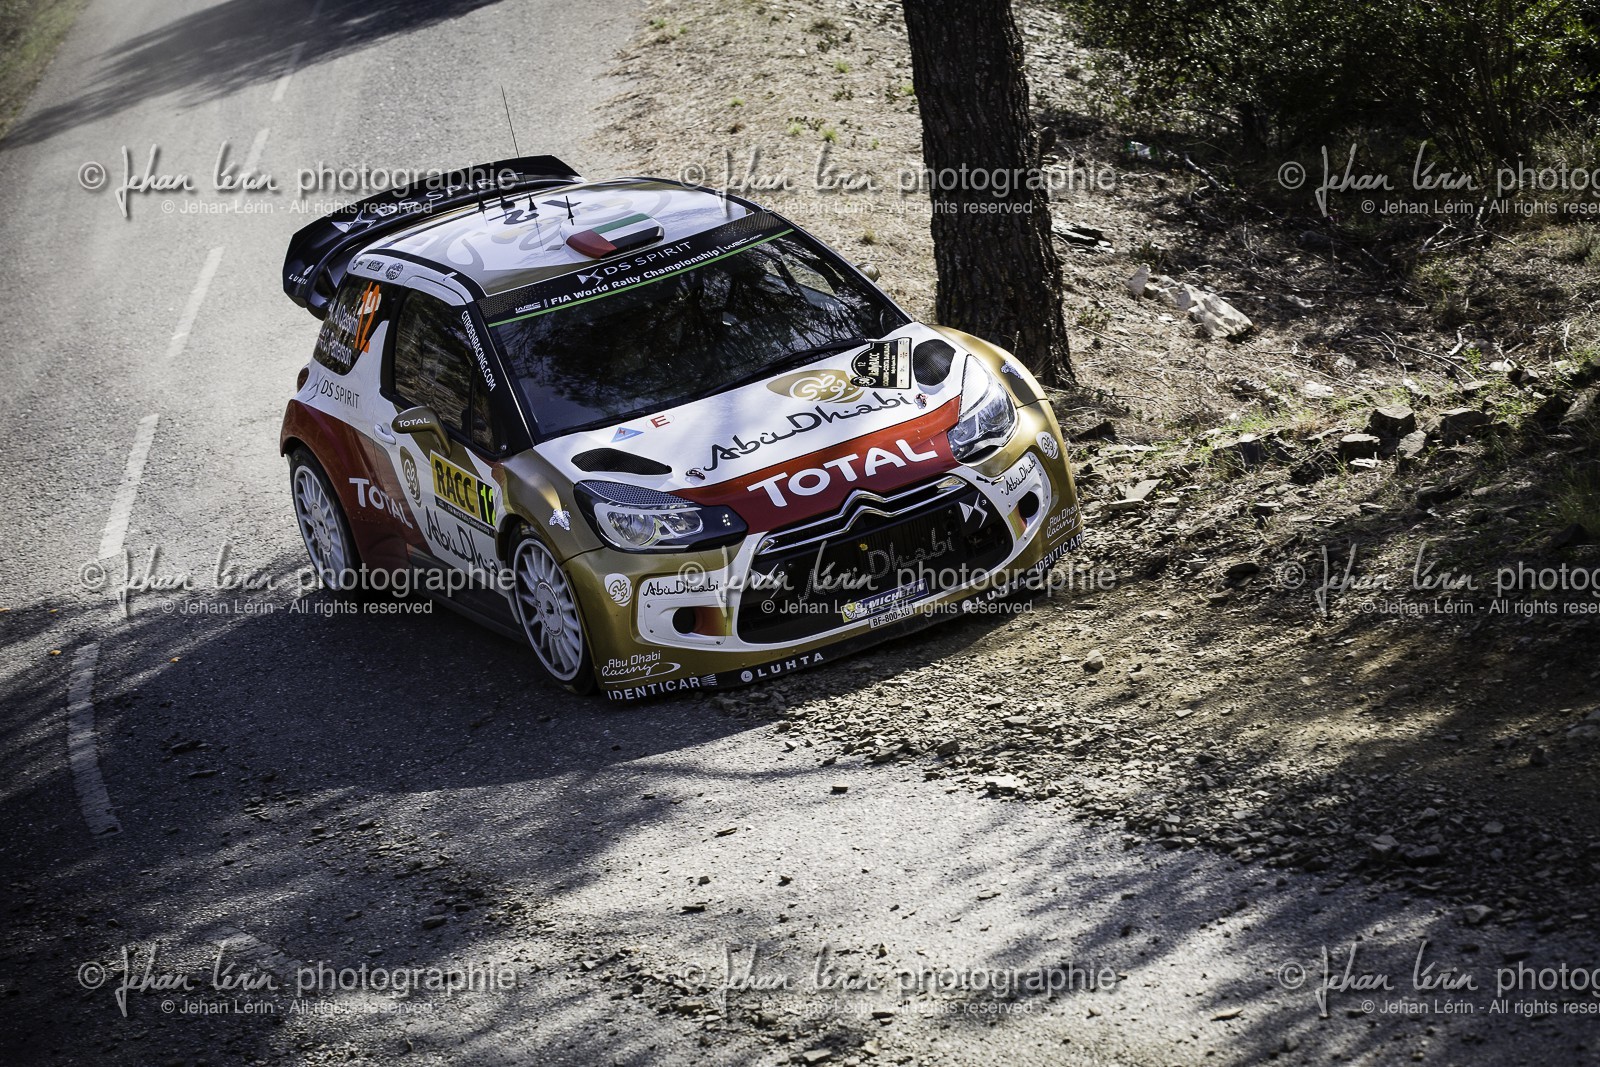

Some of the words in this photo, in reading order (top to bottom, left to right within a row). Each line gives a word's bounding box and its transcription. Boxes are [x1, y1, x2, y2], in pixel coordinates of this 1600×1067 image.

[603, 261, 632, 275] DS
[634, 241, 691, 267] SPIRIT
[551, 293, 572, 305] FIA
[573, 284, 609, 299] World
[611, 275, 641, 288] Rally
[643, 246, 720, 279] Championship
[320, 379, 335, 398] DS
[334, 385, 360, 408] SPIRIT
[398, 417, 430, 428] TOTAL
[650, 415, 671, 428] E
[434, 459, 475, 514] RACC
[746, 439, 939, 508] TOTAL
[349, 477, 413, 529] TOTAL
[1046, 513, 1078, 538] Racing
[1035, 533, 1083, 573] IDENTICAR
[601, 662, 660, 677] Racing
[608, 658, 628, 668] Abu
[630, 650, 661, 665] Dhabi
[757, 652, 825, 677] LUHTA
[607, 676, 700, 701] IDENTICAR
